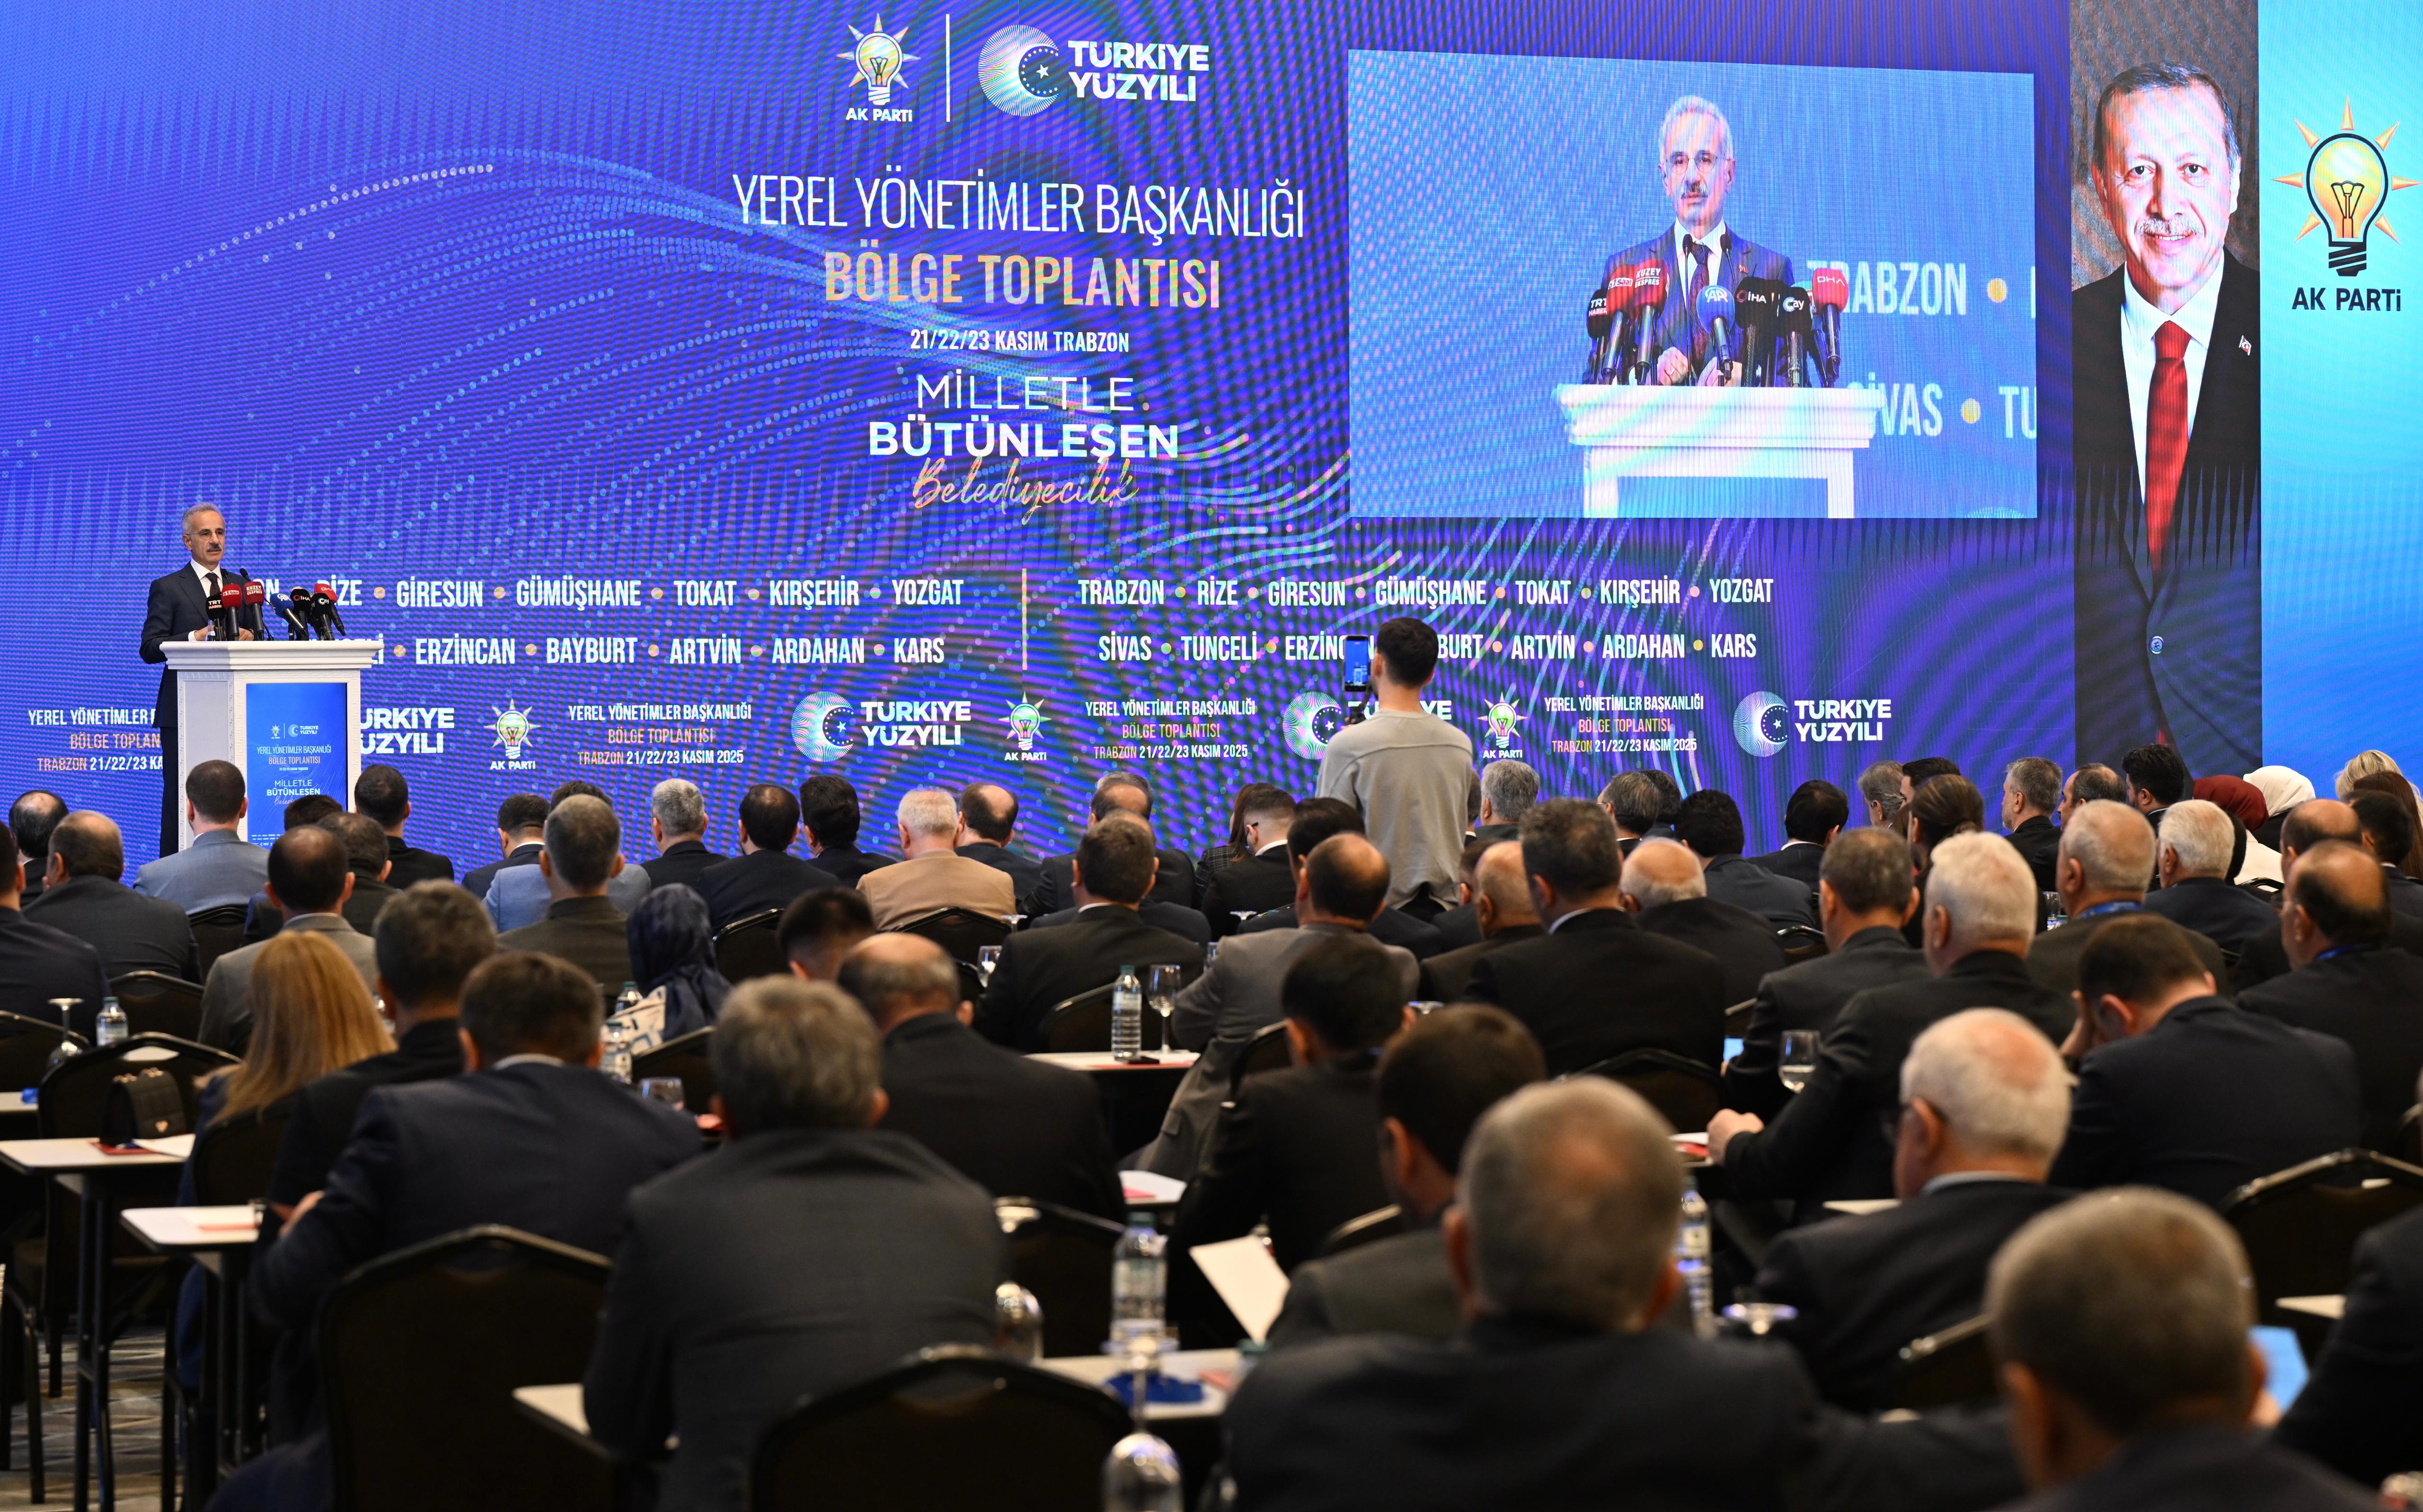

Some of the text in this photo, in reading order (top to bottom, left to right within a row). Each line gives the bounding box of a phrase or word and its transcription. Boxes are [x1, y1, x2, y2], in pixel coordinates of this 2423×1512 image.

[846, 108, 868, 122] AK
[732, 164, 1303, 246] YEREL YÖNETİMLER BAŞKANLIĞI
[825, 239, 1220, 308] BÖLGE TOPLANTISI
[1636, 268, 1662, 277] KUZEY
[2291, 287, 2326, 310] AK
[911, 328, 1129, 352] 21/22/23 KASIM TRABZON
[917, 369, 1134, 411] MİLLETLE
[1847, 372, 1943, 436] VAS
[869, 414, 1178, 462] BÜTÜNLEŞEN
[911, 455, 1140, 525] Belediyecilik
[397, 576, 483, 608] GİRESUN
[516, 575, 641, 611] GÜMÜŞHANE
[673, 580, 737, 606] TOKAT
[770, 575, 859, 610] KIRŞEHİR
[892, 580, 964, 605] YOZGAT
[1078, 575, 1774, 610] TRABZON RİZE GİRESUN GÜMÜŞHANE TOKAT KIRŞEHİR YOZGAT
[416, 633, 944, 664] ERZİNCAN BAYBURT ARTVİN ARDAHAN KARS
[1098, 630, 1757, 661] SİVAS TUNCELİ ERZİNN BURT ARTVİN ARDAHAN KARS
[568, 701, 752, 722] YEREL YÖNETİMLER BAŞKANLIĞI
[1085, 697, 1256, 718] YEREL YÖNETİMLER BAŞKANLIĞI
[1544, 693, 1704, 713] YEREL YÖNETİMLER BAŞKANLIĞI
[28, 709, 67, 725] YEREL
[70, 707, 148, 725] YÖNETİMLER
[1578, 717, 1671, 733] BÖLGE TOPLANTISI
[608, 727, 714, 743] BÖLGE TOPLANTISI
[1122, 722, 1220, 739] BÖLGE TOPLANTISI
[70, 731, 109, 749] BÖLGE
[1551, 738, 1698, 752] TRABZON 21/22/23 KASIM 2025
[273, 744, 302, 754] YÖNETİMLER
[303, 744, 332, 755] BAŞKANLIĞI
[577, 750, 744, 764] TRABZON 21/22/23 KASIM 2025
[1004, 752, 1019, 761] AK
[1094, 744, 1248, 759] TRABZON 21/22/23 KASIM 2025
[1482, 749, 1496, 758] AK
[37, 757, 87, 771] TRABZON
[90, 756, 147, 770] 21/22/23
[268, 755, 320, 764] BÖLGE TOPLANTISI
[490, 761, 506, 770] AK
[266, 787, 320, 796] BÜTÜNLEŞEN
[274, 779, 313, 787] MİLLETLE
